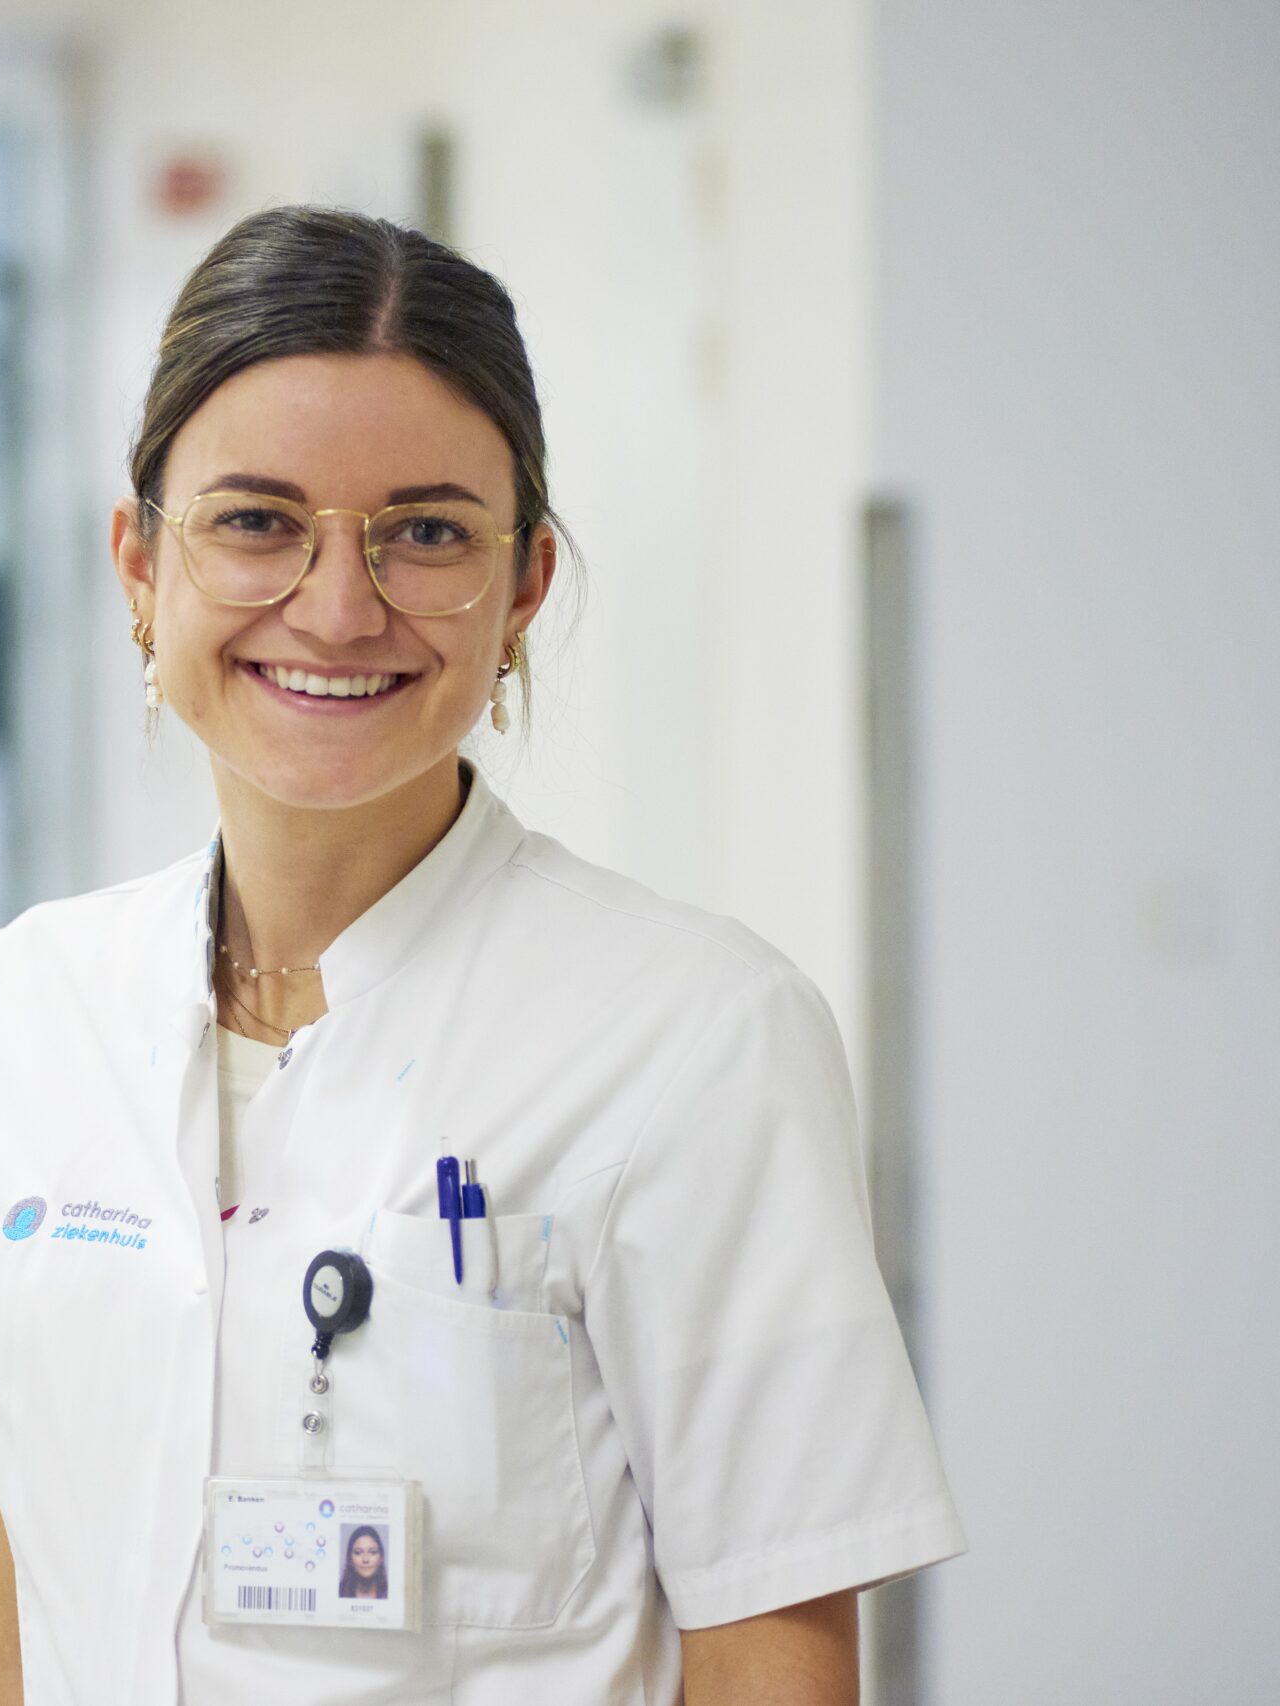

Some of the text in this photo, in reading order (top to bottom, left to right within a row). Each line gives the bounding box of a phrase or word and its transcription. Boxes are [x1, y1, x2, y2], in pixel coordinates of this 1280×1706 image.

[61, 1200, 152, 1229] catharina
[51, 1223, 148, 1250] ziekenhuis
[339, 1503, 389, 1514] catharina
